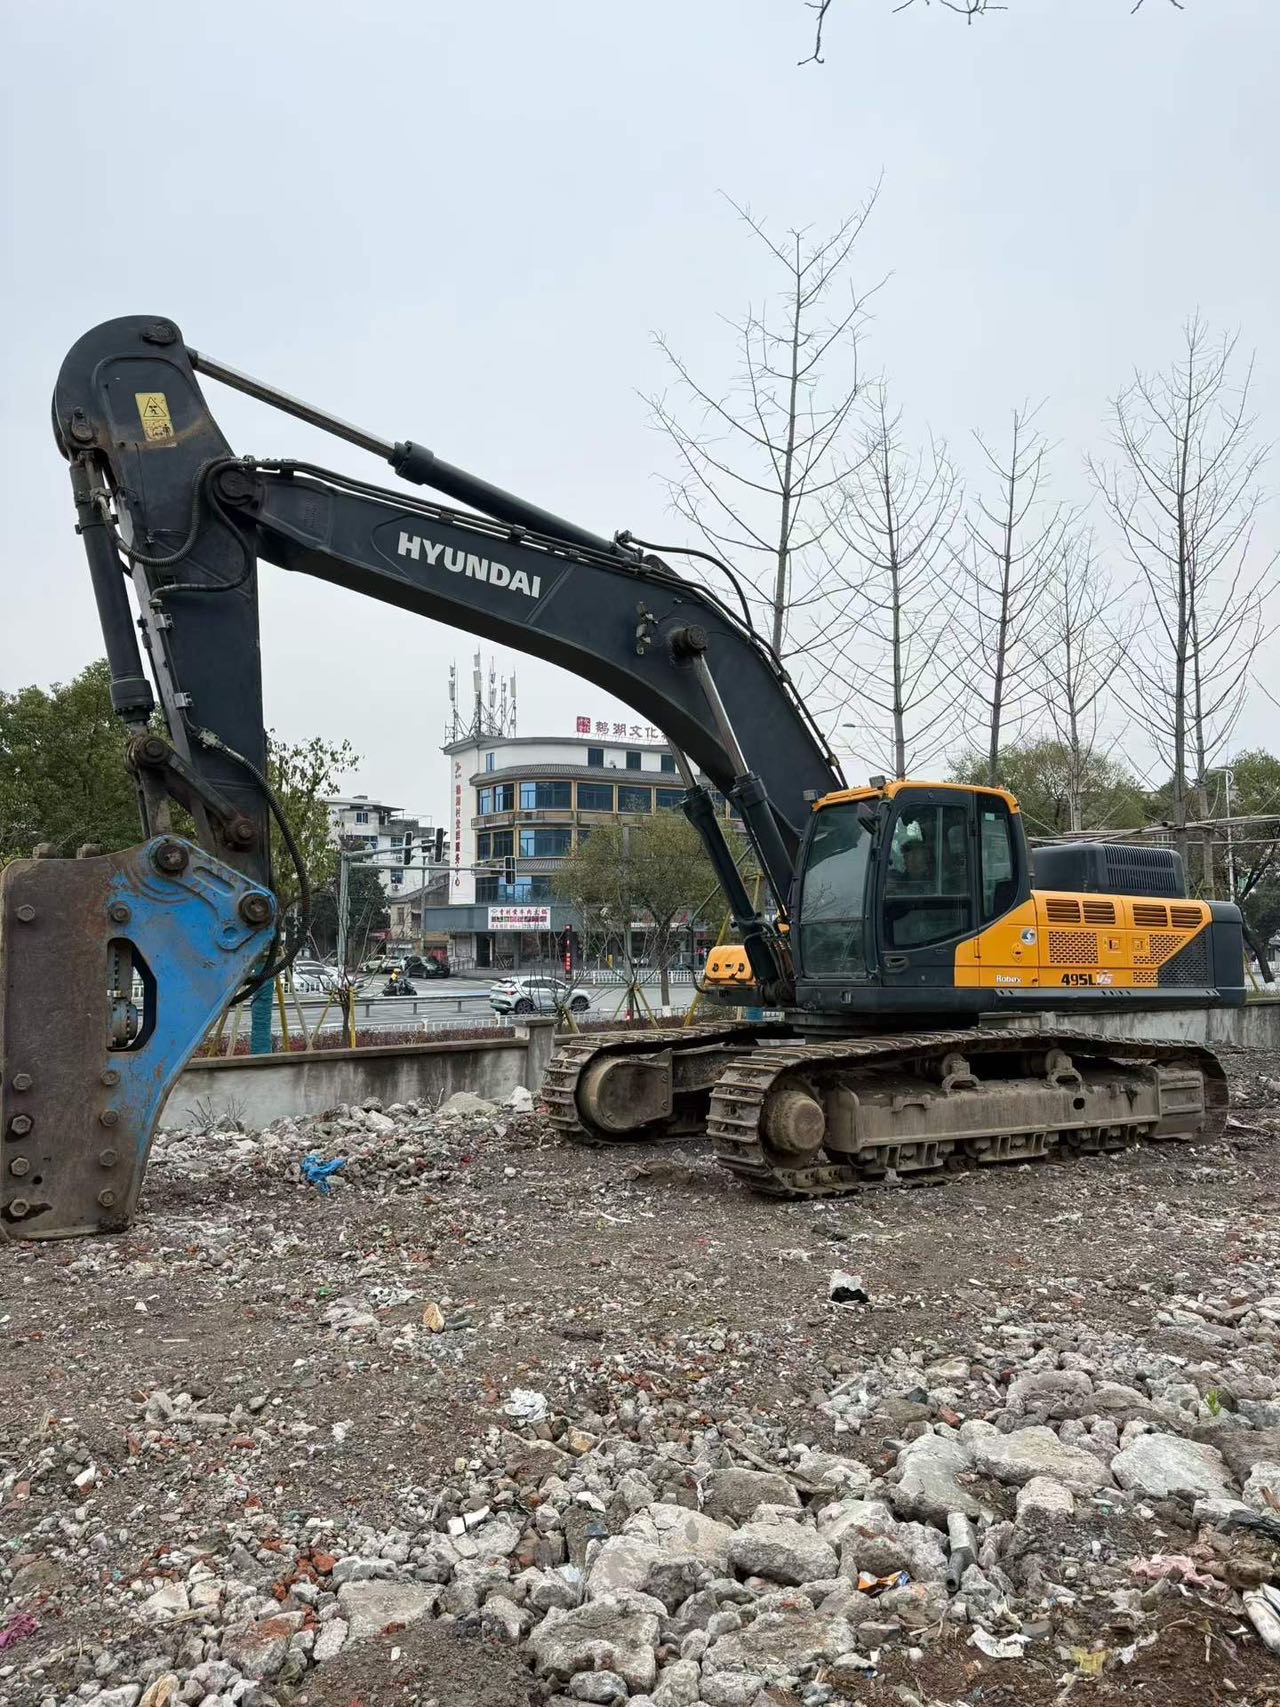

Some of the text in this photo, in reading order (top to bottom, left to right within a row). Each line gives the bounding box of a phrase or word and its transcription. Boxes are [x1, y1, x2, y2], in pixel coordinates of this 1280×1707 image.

[397, 531, 541, 599] HYUNDAI
[595, 721, 668, 741] 鹅湖文化
[996, 974, 1022, 983] Robex
